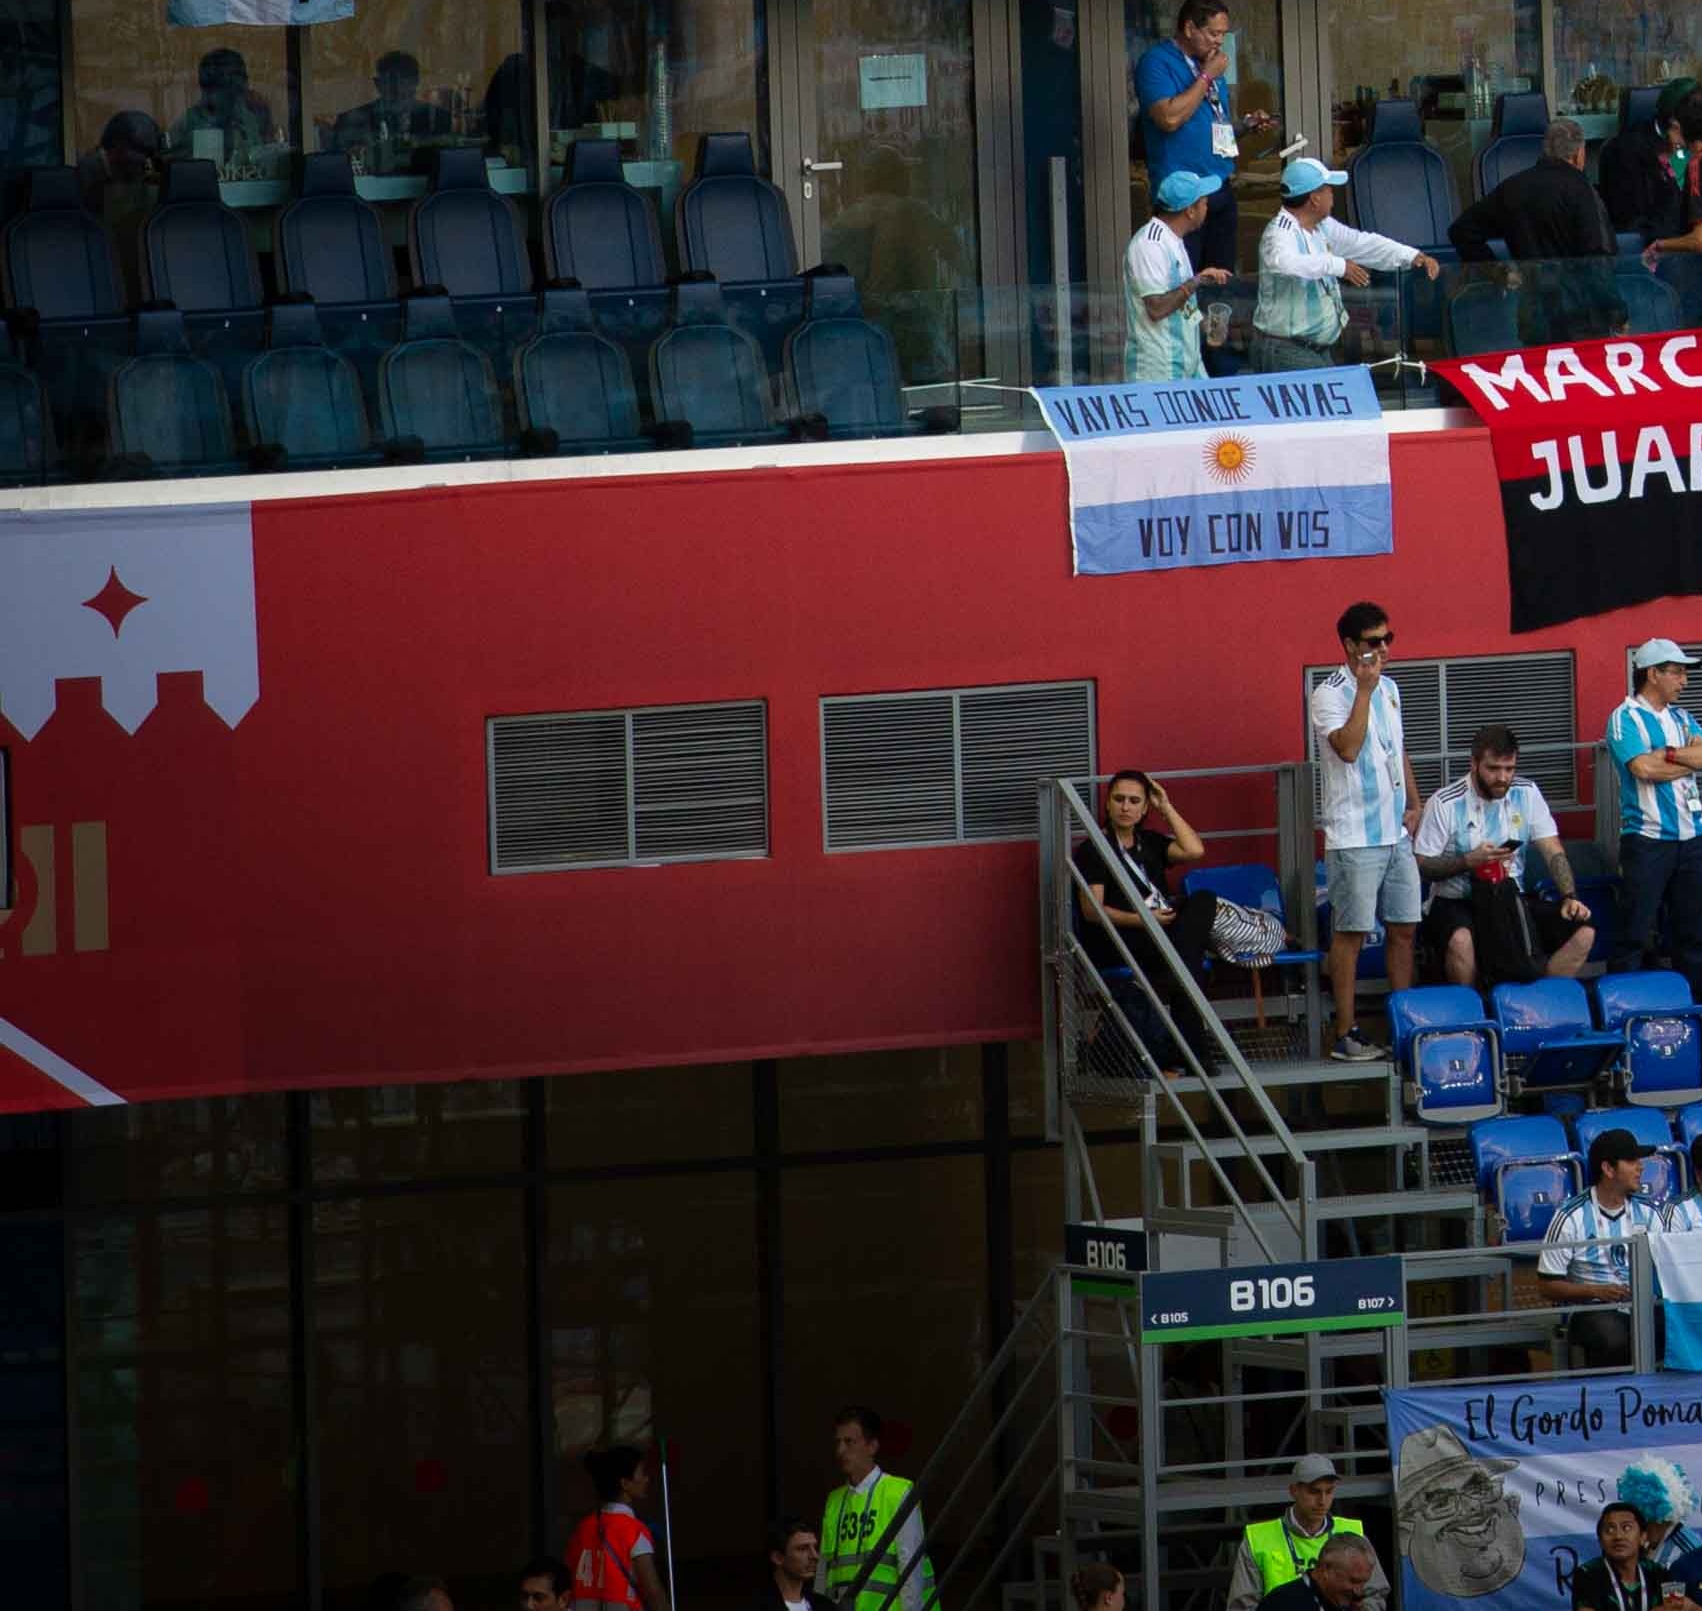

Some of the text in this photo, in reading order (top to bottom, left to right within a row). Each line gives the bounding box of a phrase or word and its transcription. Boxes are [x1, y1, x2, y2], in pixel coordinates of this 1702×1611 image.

[1054, 381, 1352, 436] VAYAS DONDE VAYAS
[1138, 509, 1331, 559] VOY CON VOS
[1087, 1240, 1126, 1270] B106
[1230, 1275, 1314, 1312] B106
[1358, 1298, 1384, 1309] B107
[1160, 1312, 1189, 1324] B105
[1462, 1397, 1497, 1444] El
[1509, 1389, 1604, 1446] Gordo
